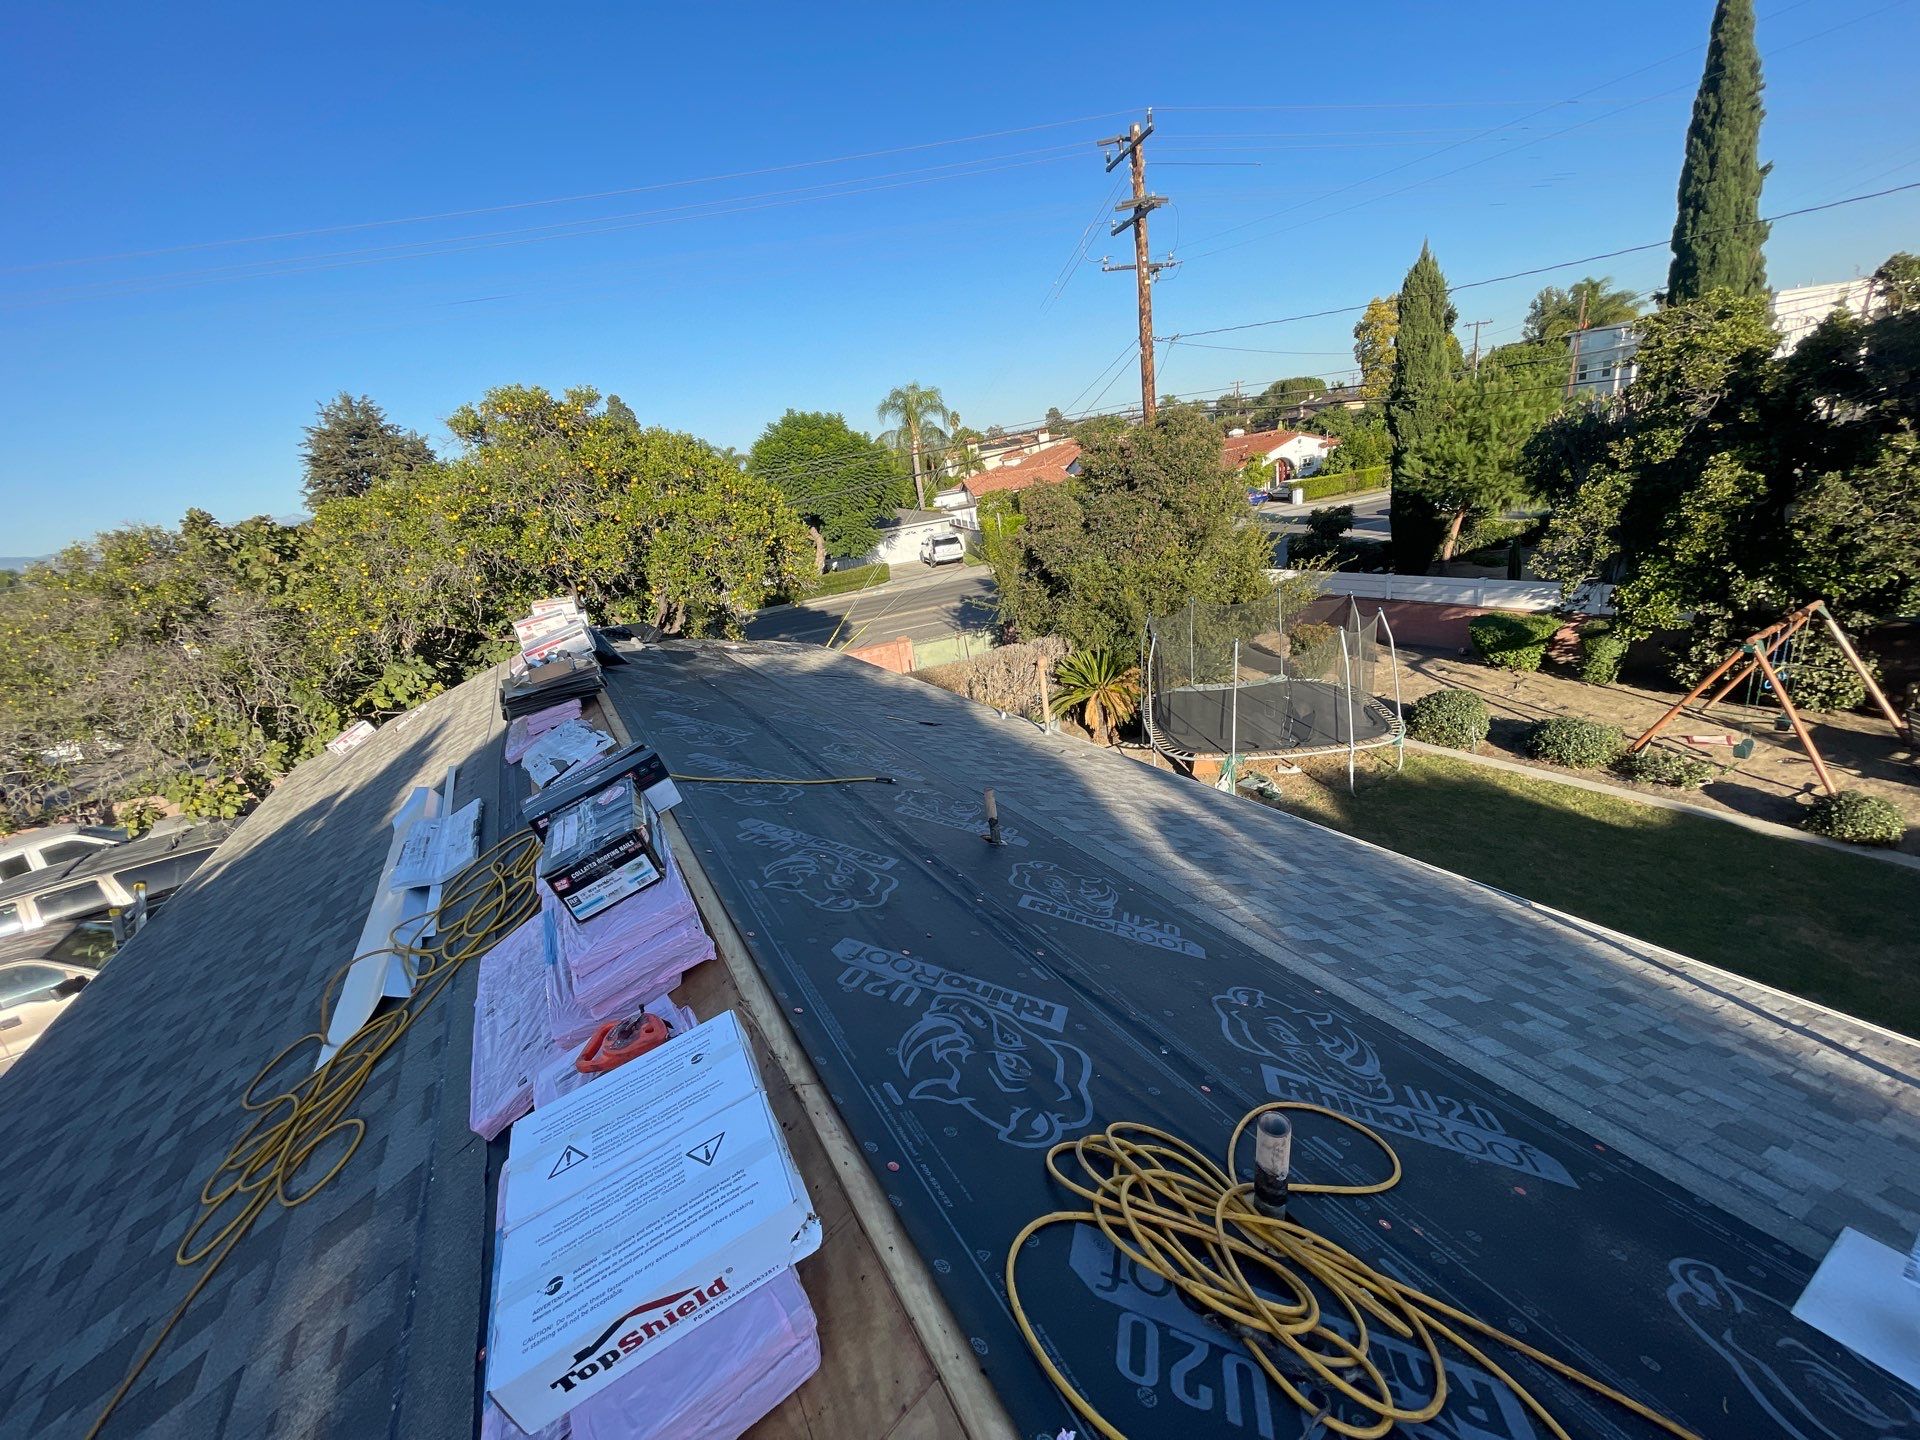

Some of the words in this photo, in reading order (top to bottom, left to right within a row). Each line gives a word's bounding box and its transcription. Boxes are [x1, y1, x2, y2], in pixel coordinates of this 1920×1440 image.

[570, 860, 597, 879] COLLATED
[595, 847, 619, 864] ROOFING
[618, 839, 634, 851] NAILS
[837, 966, 921, 1007] U20
[1403, 1085, 1507, 1135] U20
[567, 1307, 576, 1319] not
[578, 1300, 587, 1313] use
[589, 1290, 605, 1305] these
[607, 1272, 633, 1294] fasteners
[634, 1266, 643, 1277] for
[643, 1260, 654, 1271] any
[655, 1244, 678, 1264] external
[679, 1225, 710, 1249] application
[710, 1214, 727, 1229] where
[728, 1198, 753, 1218] streaking
[530, 1328, 555, 1350] staining
[556, 1320, 567, 1333] will
[569, 1313, 579, 1326] not
[550, 1275, 730, 1393] TopShield
[1116, 1312, 1277, 1440] U20
